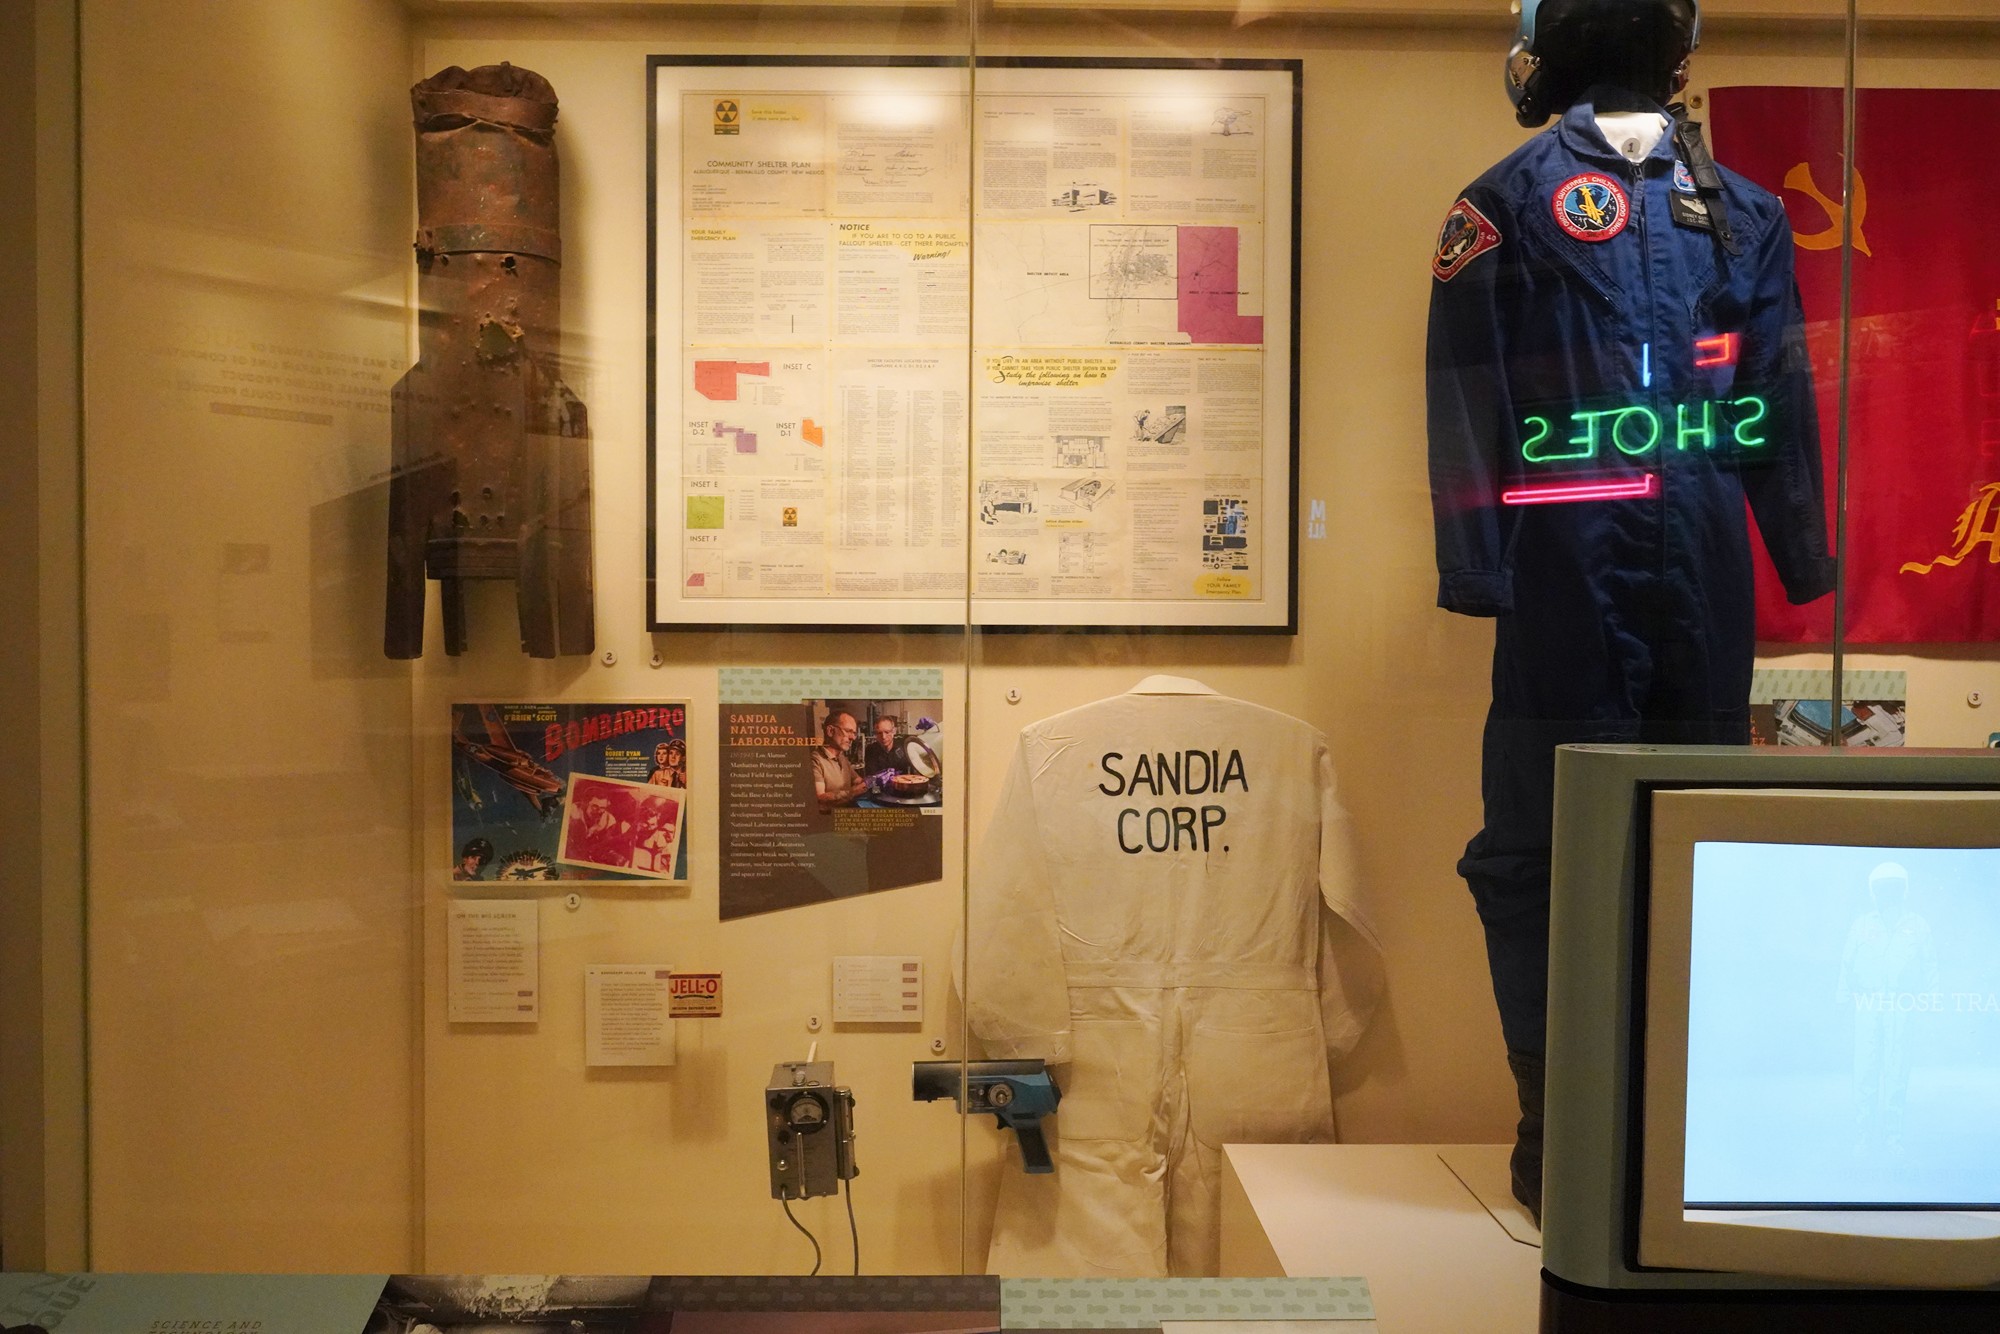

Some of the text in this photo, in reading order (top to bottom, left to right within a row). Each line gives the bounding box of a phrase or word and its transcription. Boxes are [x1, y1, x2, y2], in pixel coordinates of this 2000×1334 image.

[1627, 143, 1634, 152] 1
[1558, 177, 1588, 200] GUTIERREZ
[1592, 177, 1618, 192] CHILTON
[1556, 200, 1569, 226] CLIFFORD
[1568, 226, 1581, 235] APT
[1609, 218, 1624, 235] JONES
[913, 250, 951, 261] Warning!
[1038, 372, 1070, 380] following
[1010, 690, 1017, 698] 1
[1973, 693, 1978, 701] 3
[730, 714, 777, 723] SANDIA
[730, 726, 794, 734] NATIONAL
[544, 708, 684, 762] BOMBARDERO
[730, 738, 824, 746] LABORATORIES
[1098, 749, 1248, 796] SANDIA
[1117, 805, 1229, 854] CORP.
[671, 979, 717, 994] JELL-O
[1852, 992, 1944, 1012] WHOSE
[811, 1018, 817, 1026] 3
[935, 1040, 942, 1048] 2
[151, 1320, 262, 1329] SCIENCE AND
